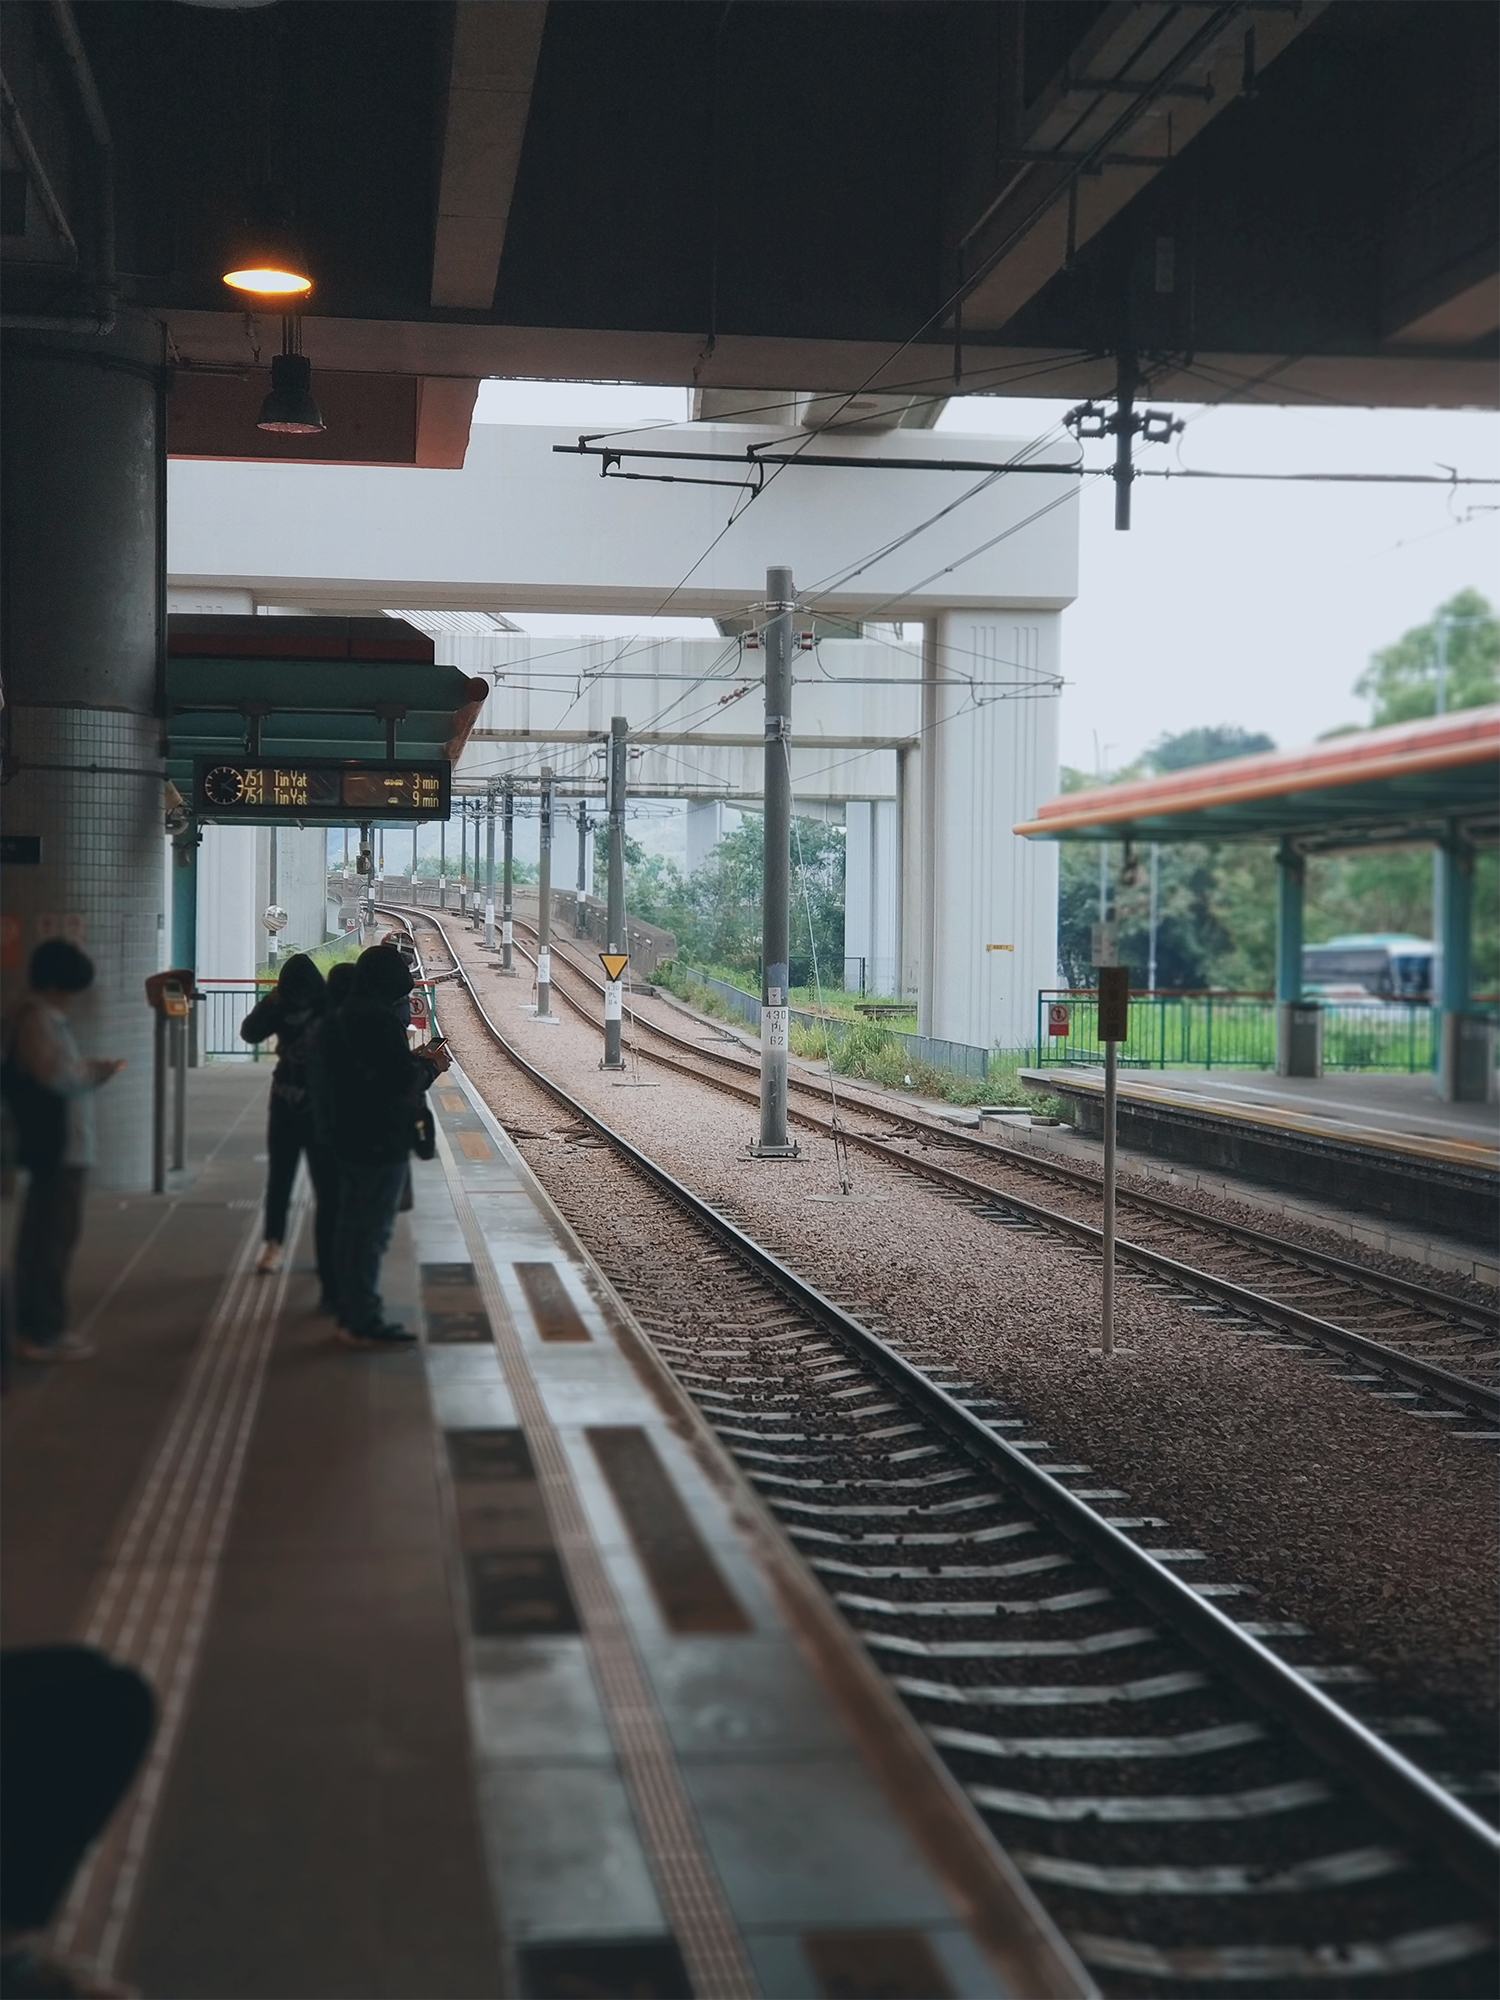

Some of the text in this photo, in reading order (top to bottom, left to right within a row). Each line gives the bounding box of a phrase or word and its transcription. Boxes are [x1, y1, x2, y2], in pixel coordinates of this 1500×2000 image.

[244, 768, 440, 790] 751 Tin Yat 3 min
[243, 786, 440, 808] 751 Tin Yat 9 min
[766, 1010, 786, 1019] 430
[770, 1036, 783, 1045] 62
